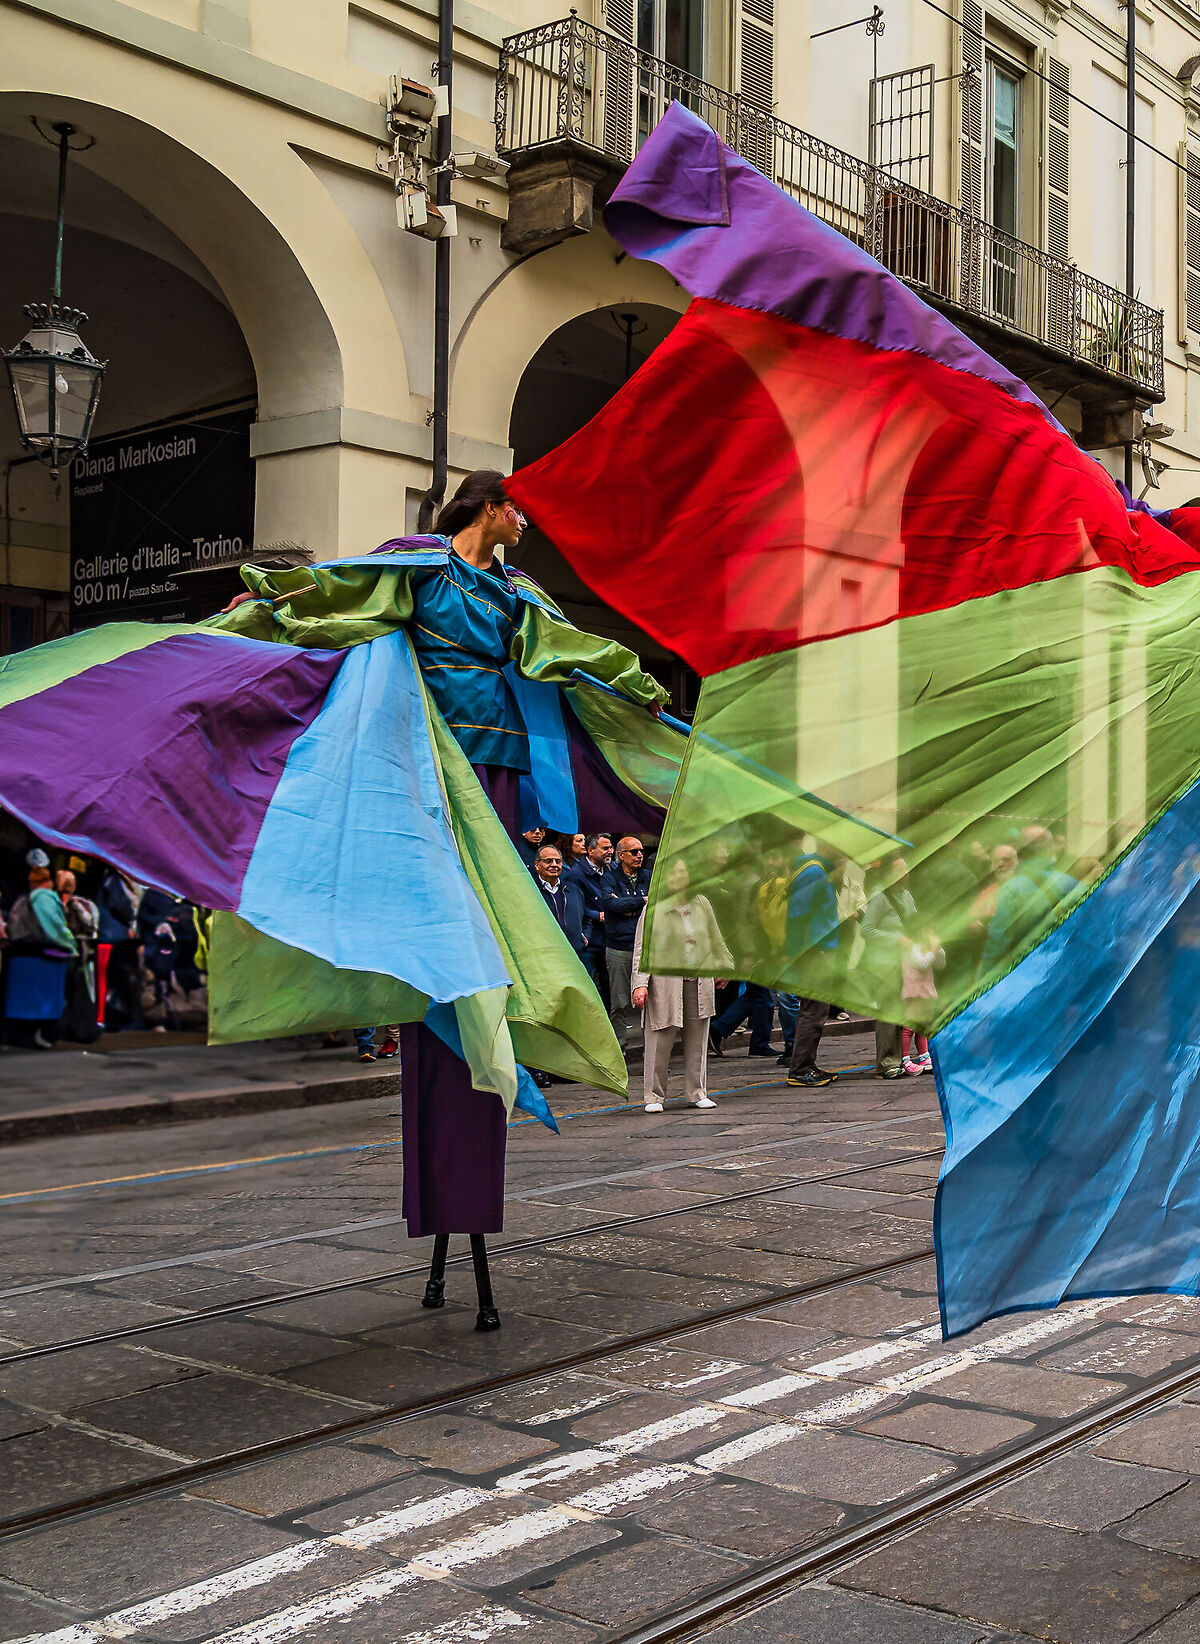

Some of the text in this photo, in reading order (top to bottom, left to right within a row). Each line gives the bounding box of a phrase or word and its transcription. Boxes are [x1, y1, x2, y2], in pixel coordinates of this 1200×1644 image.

[75, 435, 197, 479] Diana Markosian
[74, 552, 129, 581] Gallerie
[193, 534, 243, 561] Torino
[74, 581, 104, 606] 900
[129, 588, 150, 600] piazza
[151, 583, 164, 595] San
